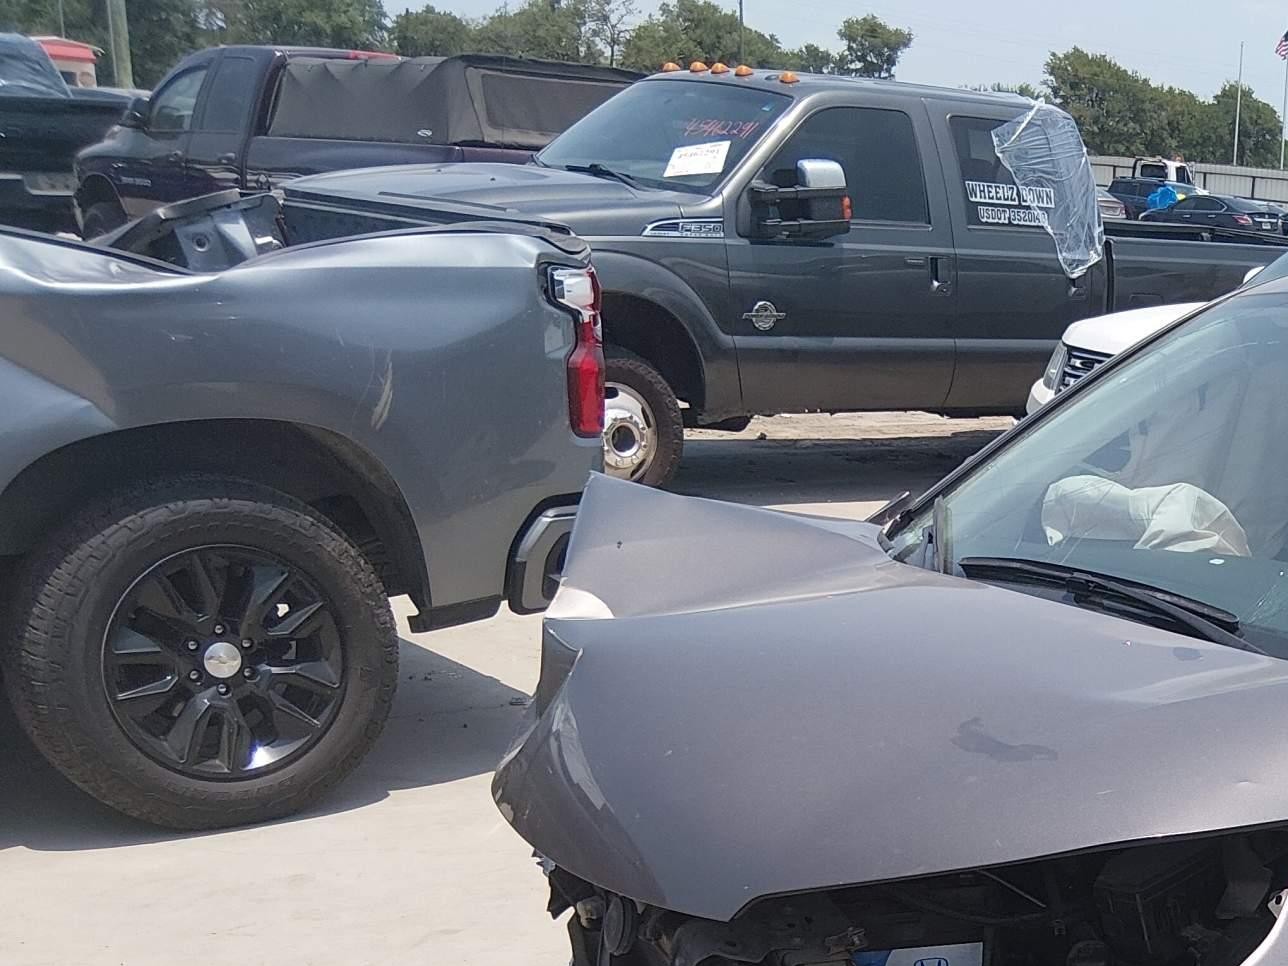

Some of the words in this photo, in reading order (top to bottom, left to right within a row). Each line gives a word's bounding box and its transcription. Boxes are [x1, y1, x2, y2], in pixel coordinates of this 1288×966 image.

[966, 181, 1019, 205] WHEELZ
[1020, 186, 1055, 208] DOWN
[978, 206, 1009, 223] USDOT
